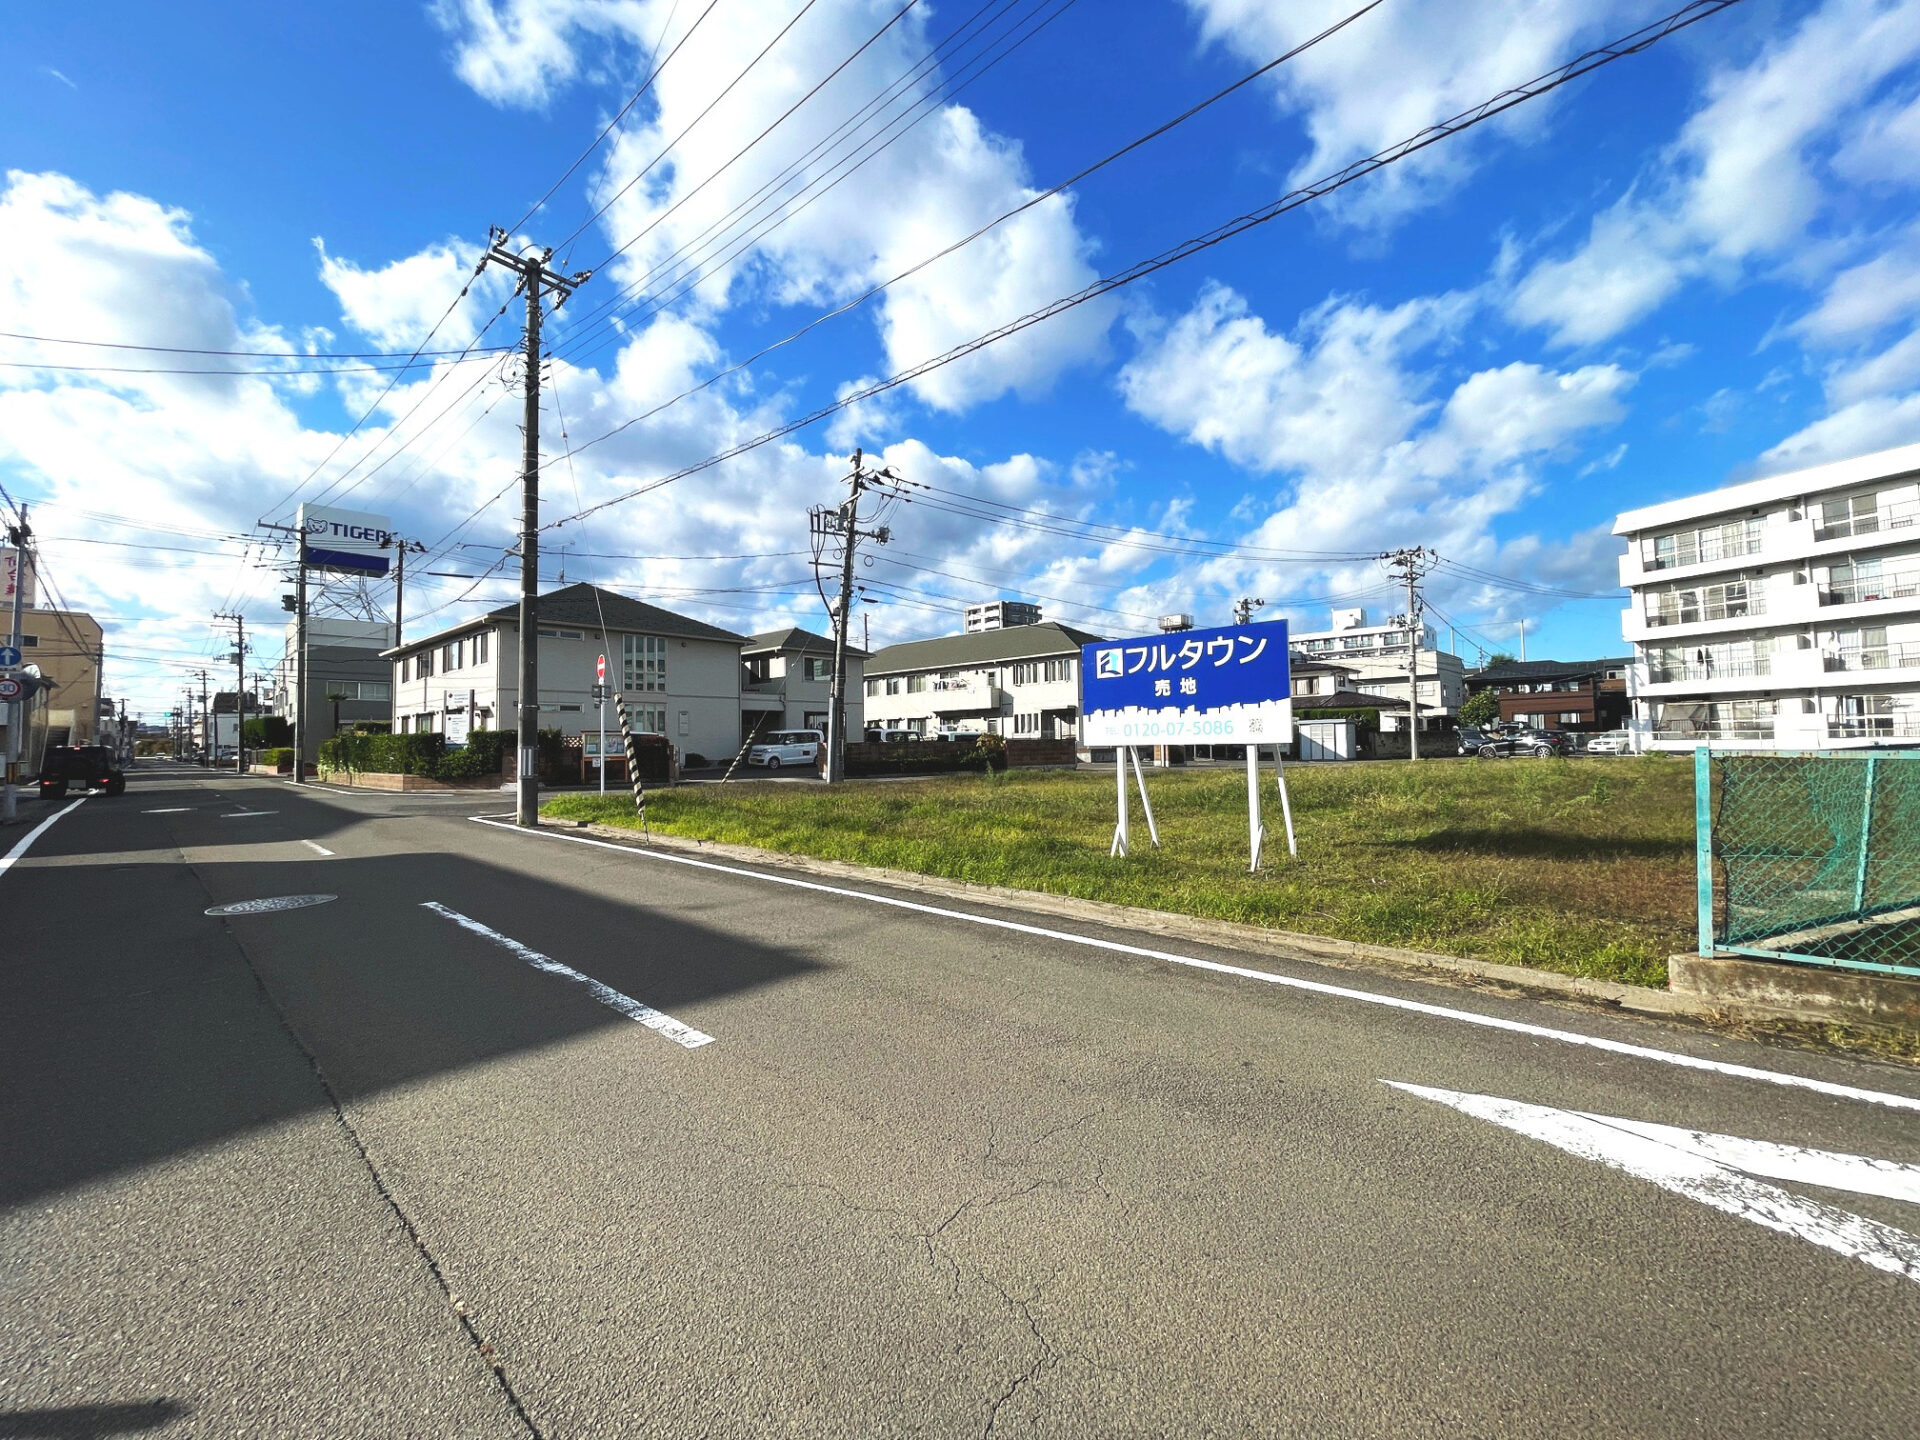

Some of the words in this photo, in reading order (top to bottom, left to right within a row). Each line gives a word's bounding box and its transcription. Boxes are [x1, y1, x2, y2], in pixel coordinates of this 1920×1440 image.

[329, 522, 388, 542] TIGER
[1125, 636, 1267, 673] フルタウン
[0, 683, 15, 693] 30
[1123, 720, 1234, 737] 0120-07-5086
